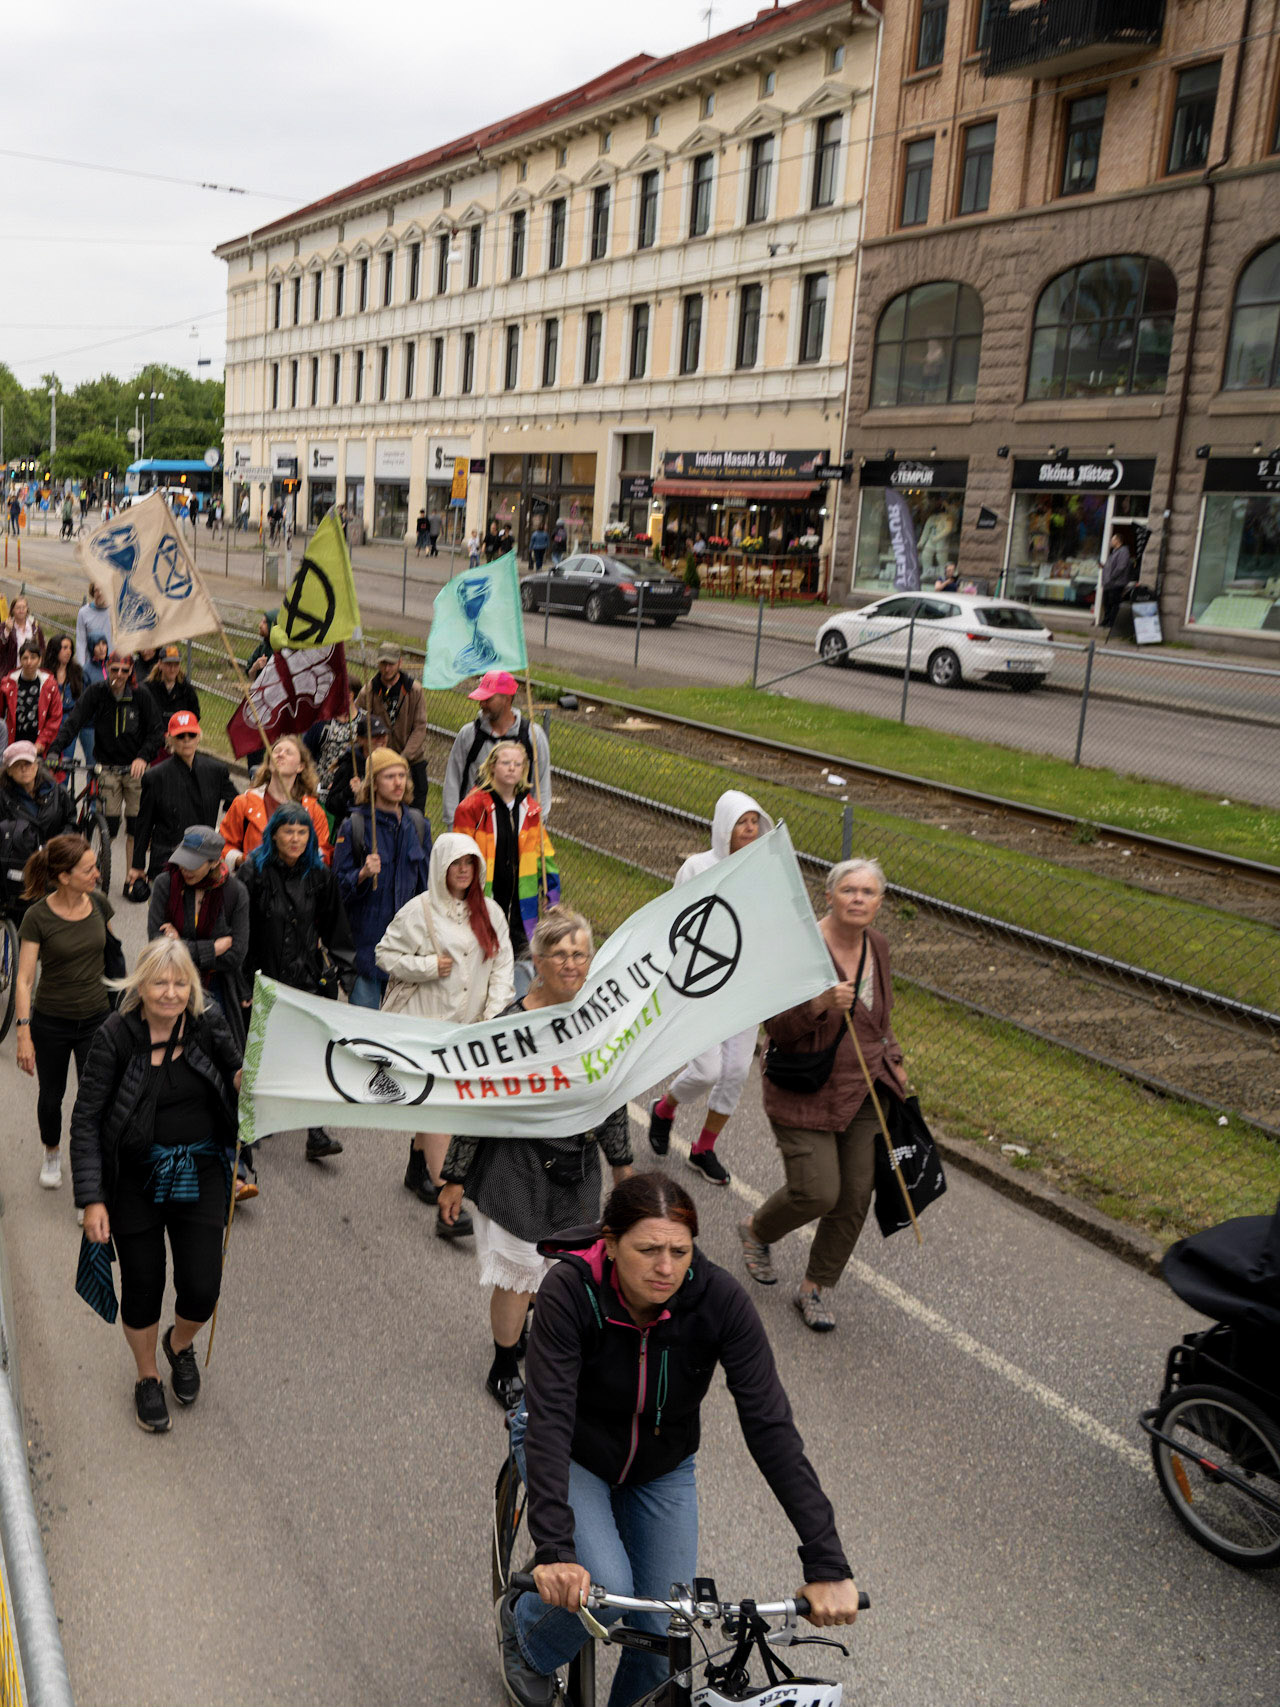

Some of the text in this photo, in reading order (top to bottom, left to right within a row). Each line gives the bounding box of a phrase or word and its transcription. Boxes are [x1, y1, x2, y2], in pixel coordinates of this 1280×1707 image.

[695, 451, 787, 467] Indian Masala & Bar
[896, 470, 935, 484] TEMPUR
[1039, 462, 1114, 483] Sköna Nätter
[887, 503, 907, 586] TEMPUR
[177, 714, 190, 725] W
[431, 952, 667, 1074] TIDEN RINNER UT
[454, 1065, 571, 1100] RÄDDA
[759, 1688, 798, 1707] LAZER
